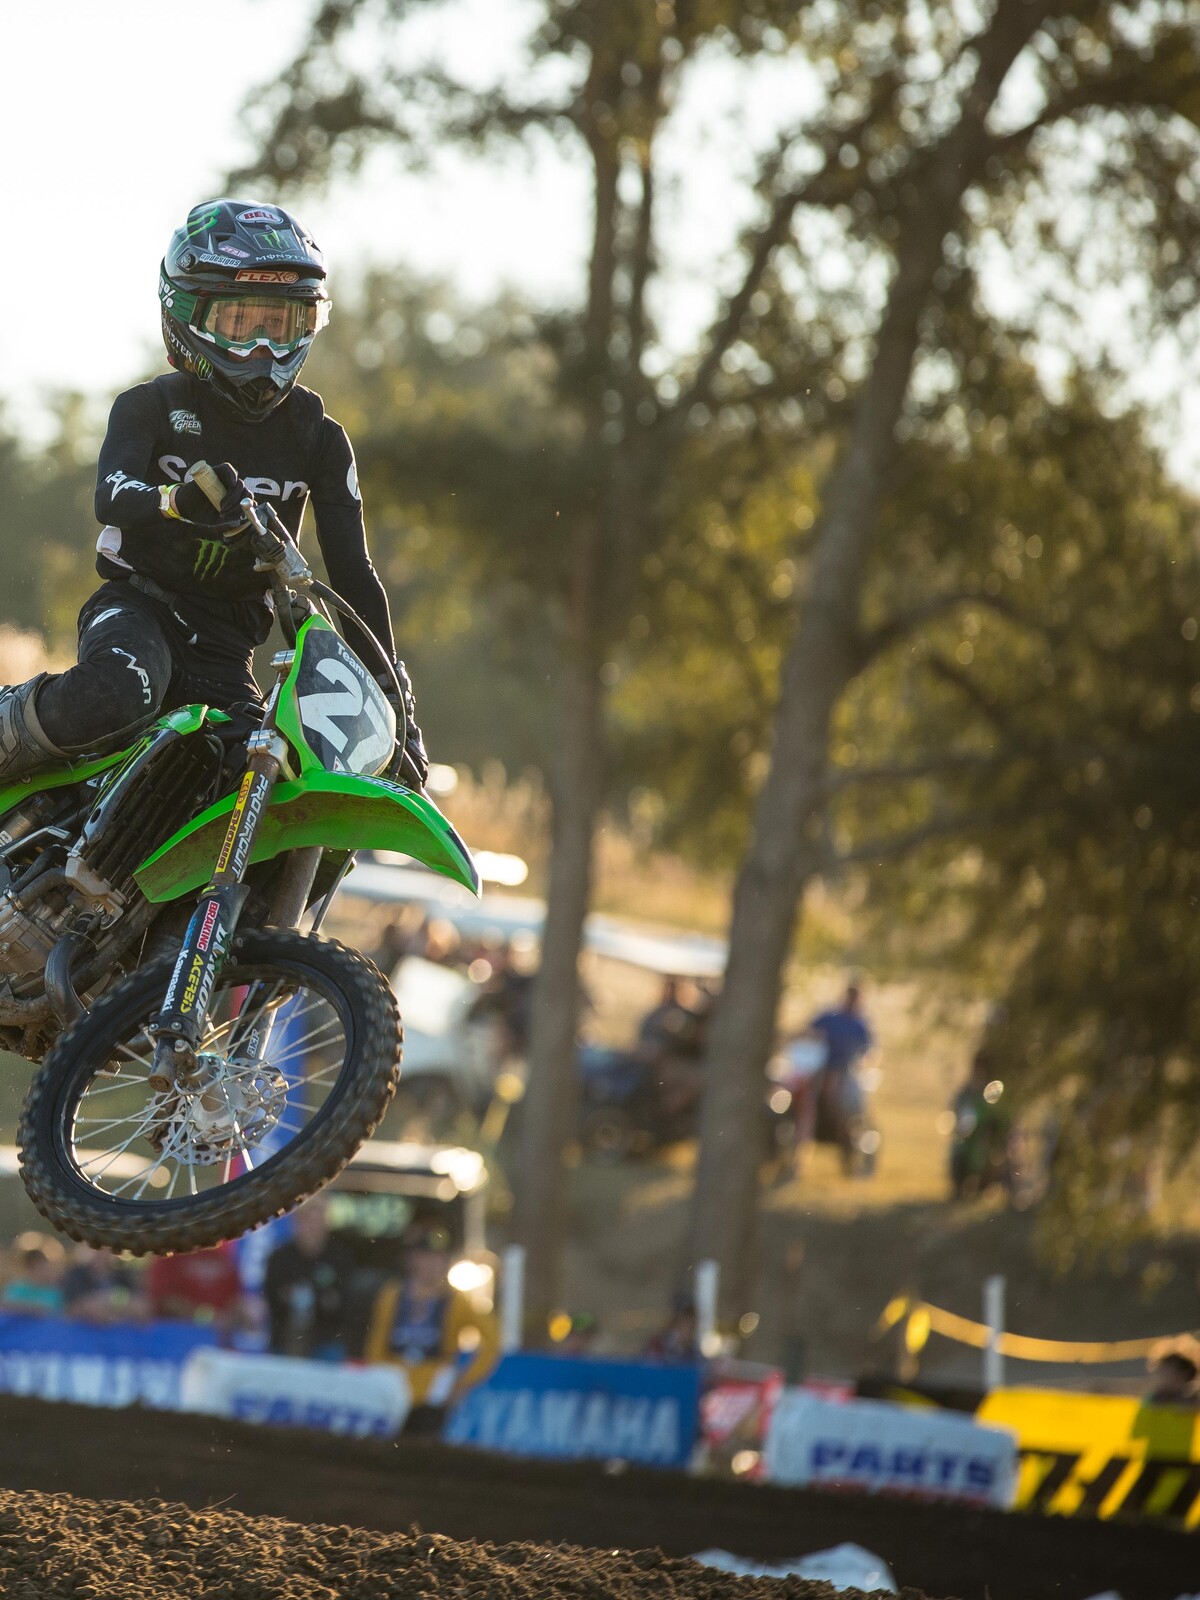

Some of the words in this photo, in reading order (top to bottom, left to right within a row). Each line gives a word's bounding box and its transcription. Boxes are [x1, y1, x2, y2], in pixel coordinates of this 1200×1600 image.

[243, 211, 277, 221] BELL
[169, 410, 195, 421] TEAM
[158, 455, 309, 502] Sen
[336, 641, 366, 679] Team
[365, 676, 386, 716] Green
[250, 774, 269, 814] PRO
[217, 808, 241, 869] SHOWA
[232, 810, 258, 878] CIRCUIT
[197, 901, 219, 951] BRAKING
[162, 949, 189, 1013] Kawasaki
[180, 953, 204, 1014] ACERBIS
[10, 1350, 185, 1409] YAMAH
[475, 1387, 681, 1461] YAMAHA
[807, 1437, 994, 1490] PARTS
